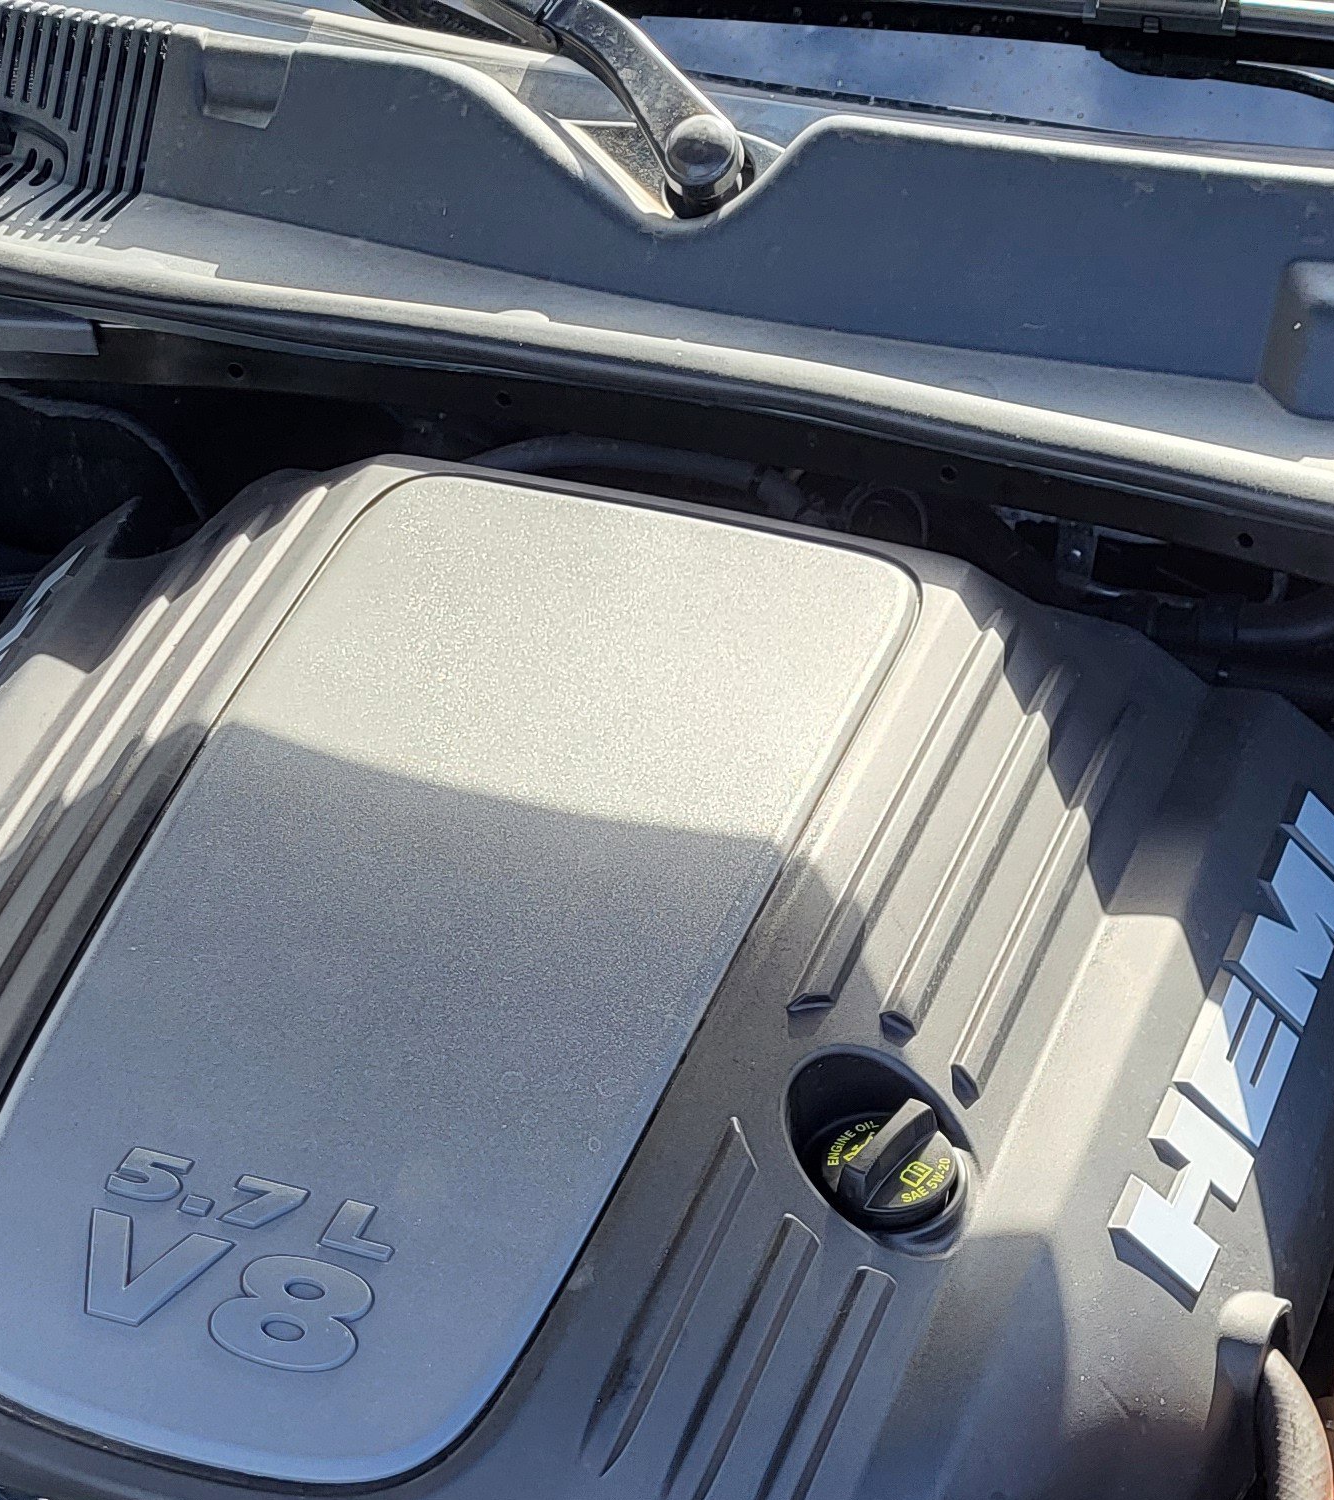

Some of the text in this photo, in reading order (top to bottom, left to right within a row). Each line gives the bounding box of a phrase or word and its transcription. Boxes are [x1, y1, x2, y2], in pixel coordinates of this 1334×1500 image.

[827, 1120, 880, 1166] ENGINE OIL
[901, 1157, 951, 1203] SAE 5W-20
[84, 1208, 375, 1372] V8
